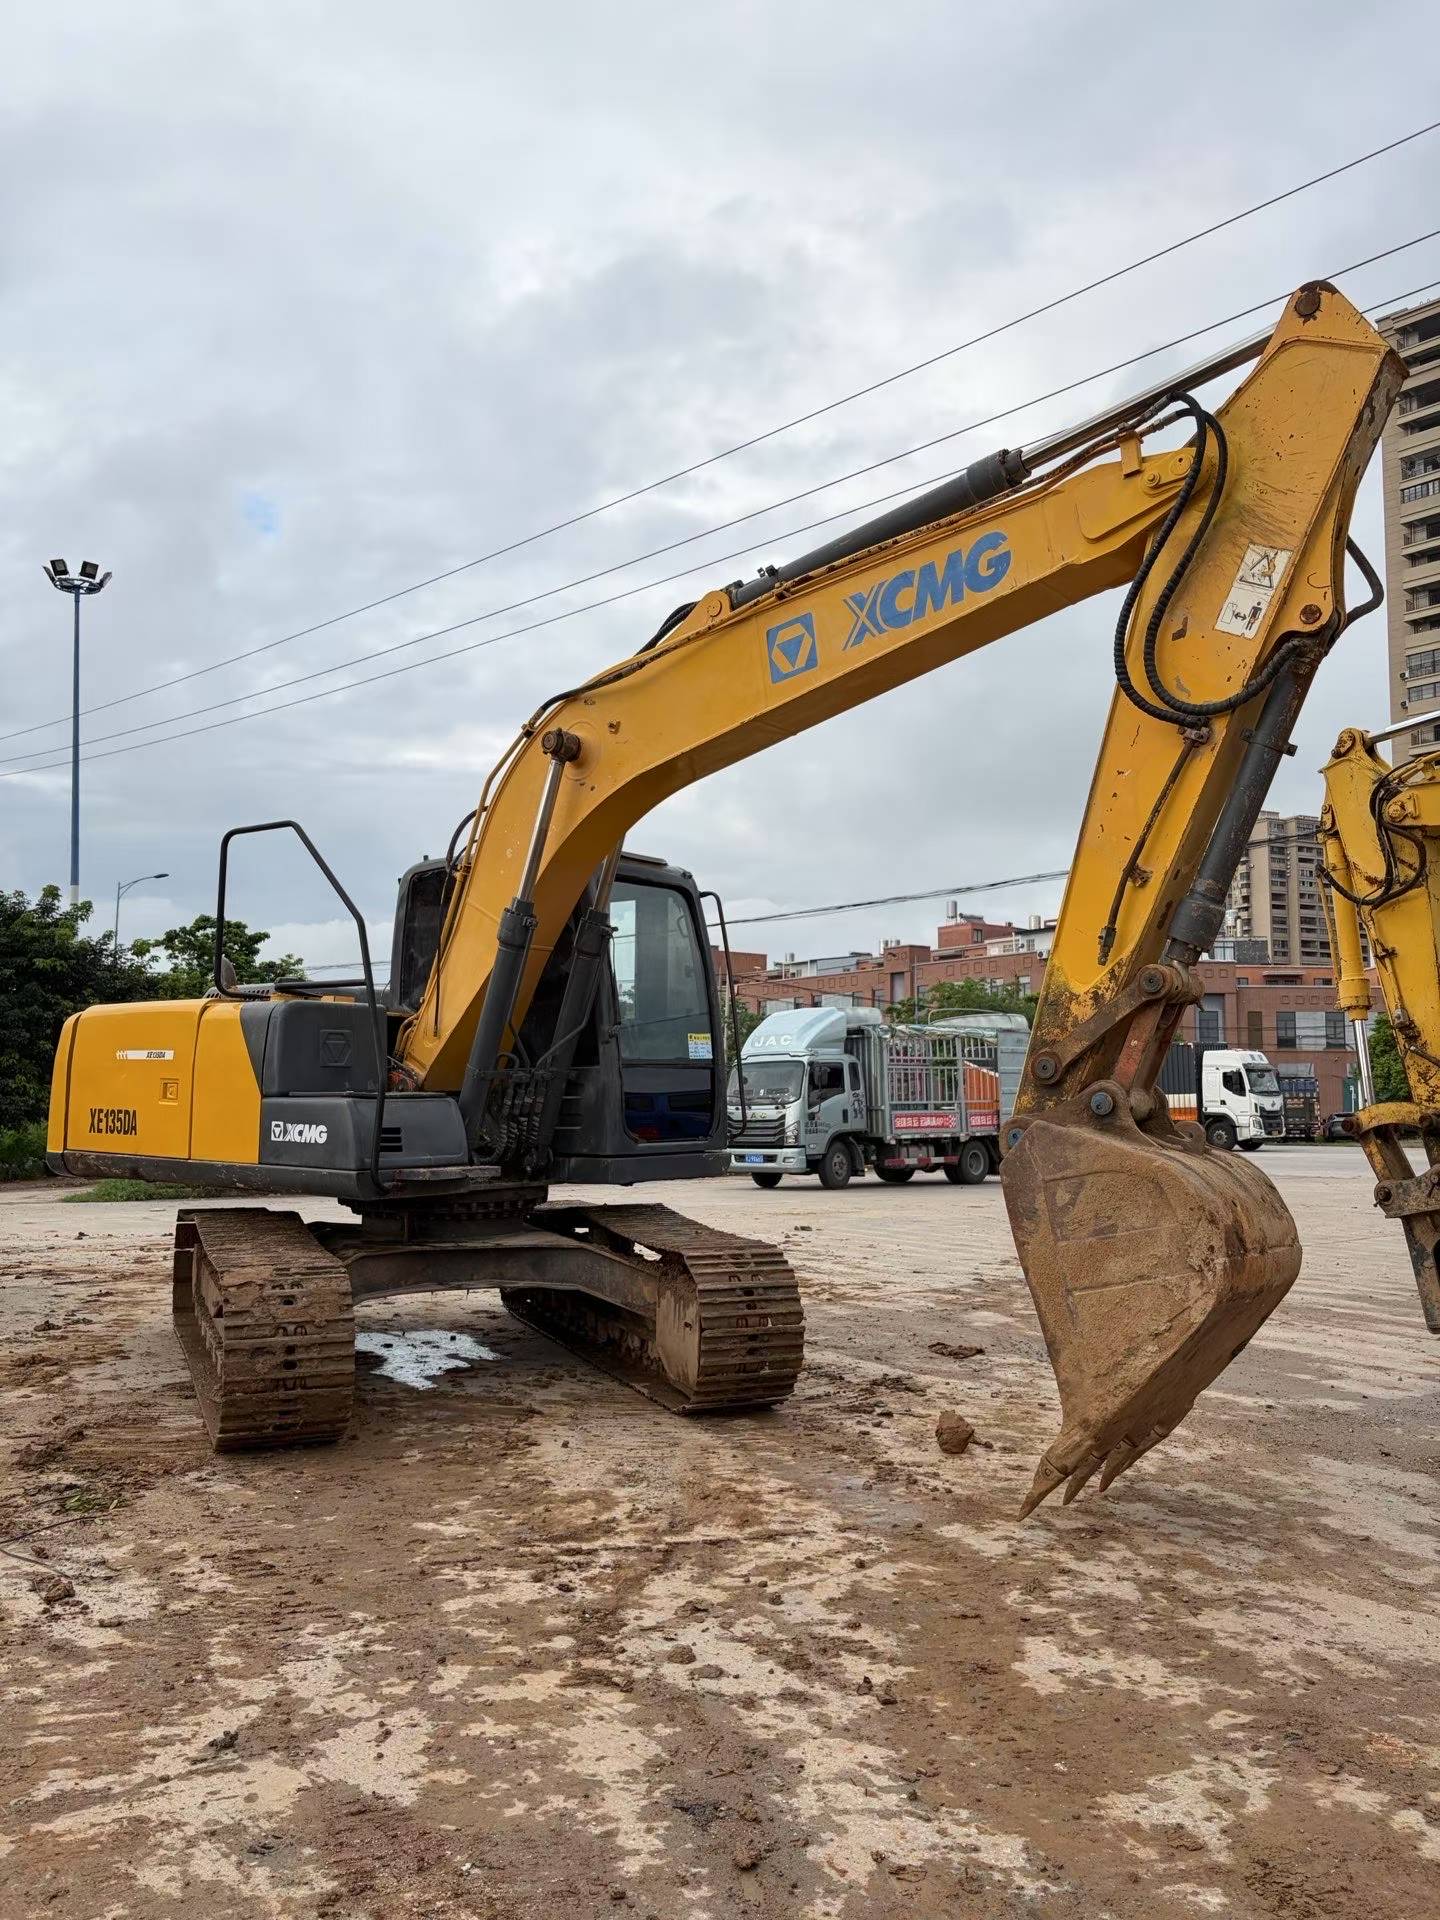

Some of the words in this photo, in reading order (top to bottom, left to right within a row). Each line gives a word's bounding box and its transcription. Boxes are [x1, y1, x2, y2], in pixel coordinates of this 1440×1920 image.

[842, 531, 1012, 651] XCMG
[754, 1034, 792, 1047] JAC
[89, 1108, 137, 1136] XE135DA
[283, 1123, 328, 1144] XCMG
